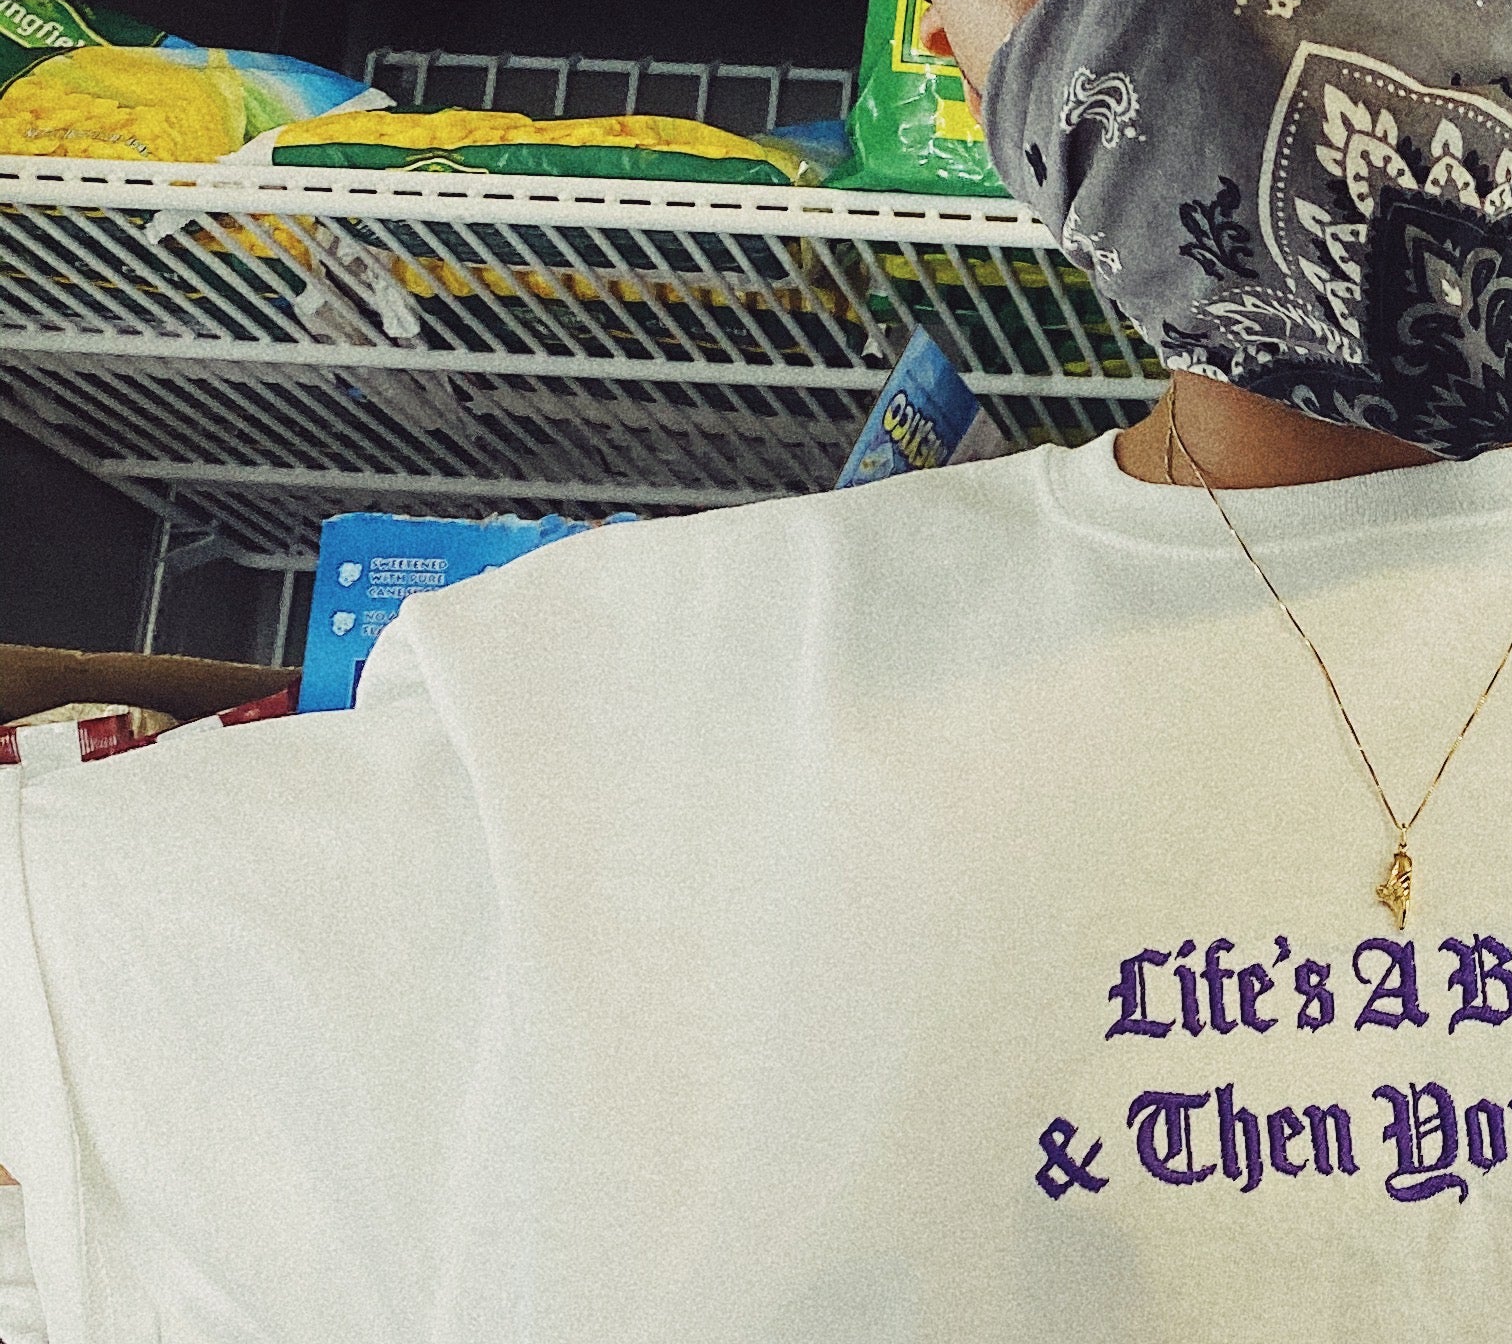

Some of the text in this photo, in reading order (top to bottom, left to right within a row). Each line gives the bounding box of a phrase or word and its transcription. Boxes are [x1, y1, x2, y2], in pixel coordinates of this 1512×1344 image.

[1352, 937, 1429, 1032] A
[1034, 1116, 1110, 1201] &
[1127, 1082, 1361, 1194] Then
